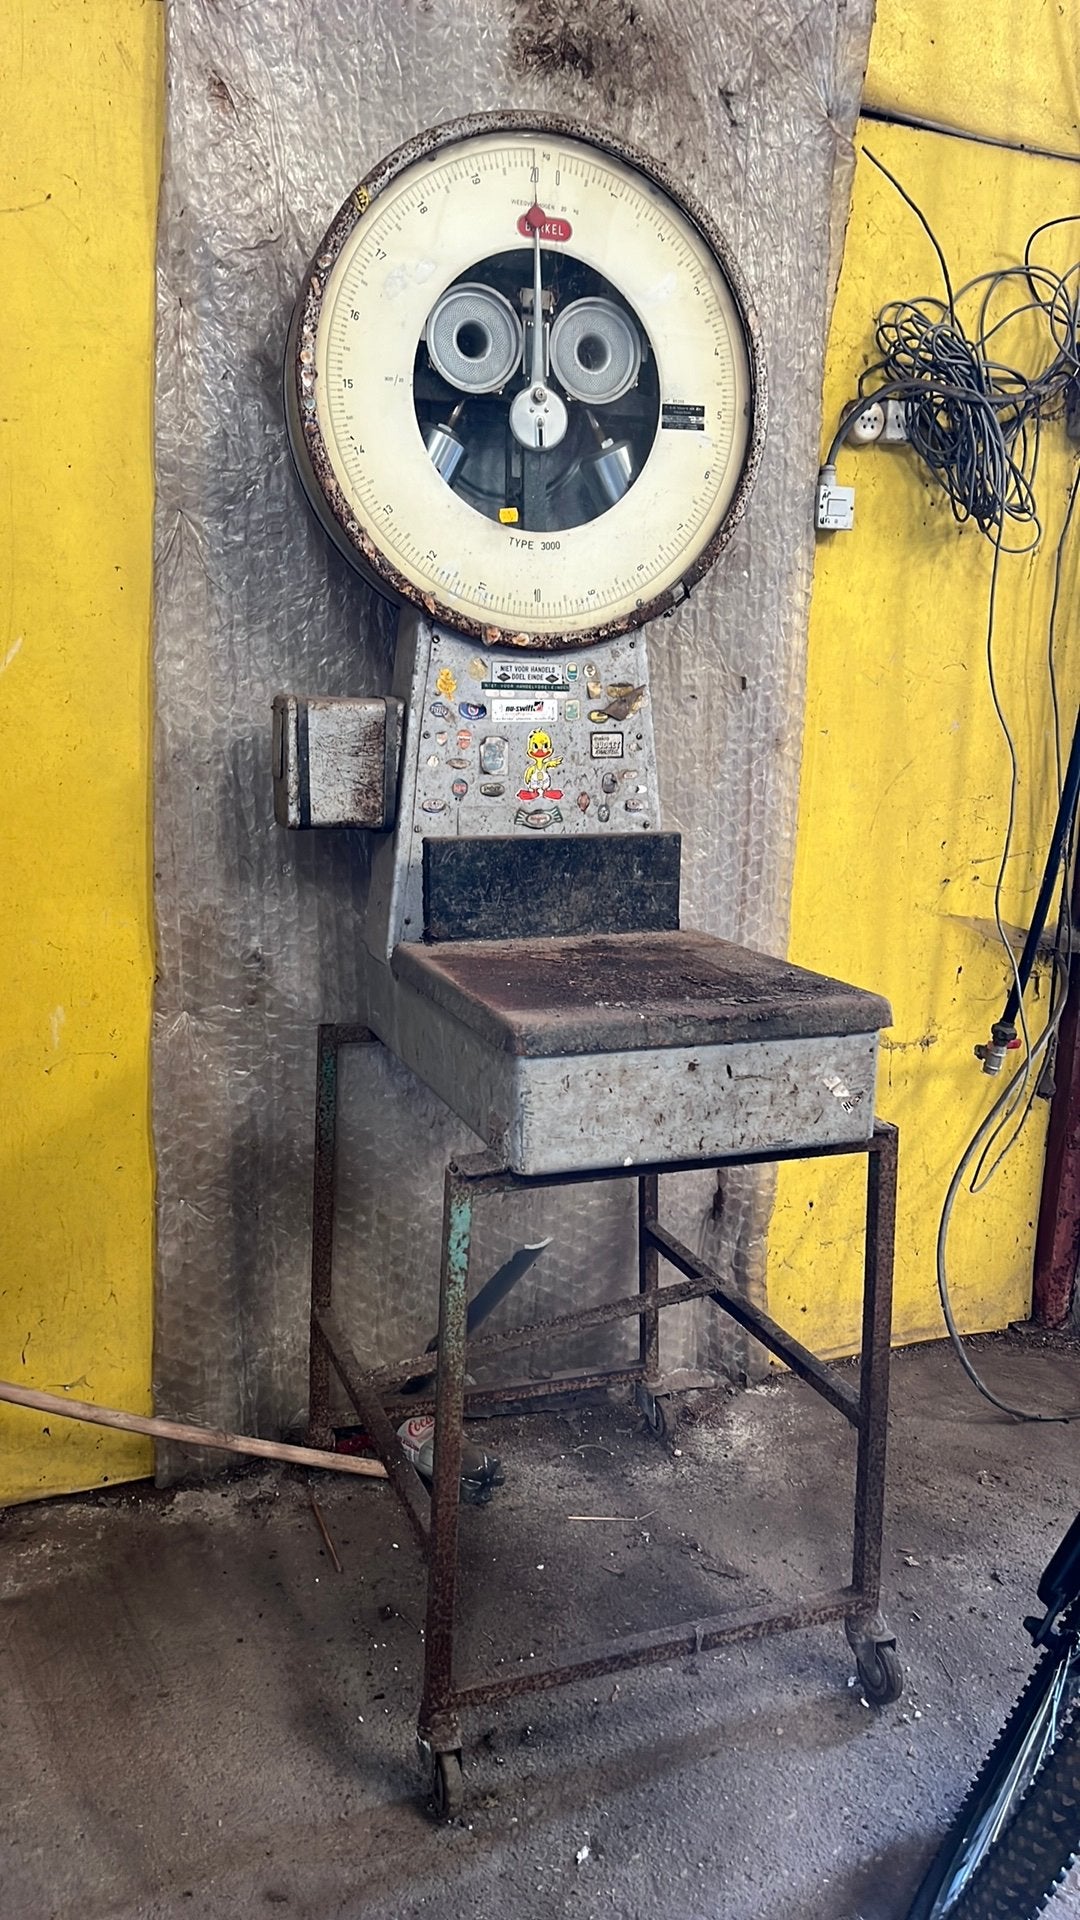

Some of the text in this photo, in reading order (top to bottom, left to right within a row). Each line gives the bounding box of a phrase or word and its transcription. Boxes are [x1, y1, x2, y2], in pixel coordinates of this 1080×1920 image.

[542, 152, 550, 161] kg
[470, 173, 481, 185] 19
[530, 166, 539, 183] 20
[555, 170, 560, 186] 0
[417, 201, 428, 214] 18
[525, 221, 564, 236] BKEL
[657, 233, 666, 242] 2
[375, 249, 387, 261] 17
[693, 286, 701, 296] 3
[350, 309, 360, 321] 16
[714, 348, 720, 356] 4
[342, 378, 354, 389] 15
[716, 410, 722, 420] 5
[353, 444, 365, 456] 14
[704, 470, 711, 480] 6
[382, 504, 394, 516] 13
[676, 523, 684, 531] 7
[509, 537, 561, 551] TYPE 3000
[426, 550, 438, 562] 12
[636, 564, 645, 572] 8
[478, 581, 488, 591] 11
[534, 588, 541, 603] 10
[587, 589, 596, 597] 9
[514, 665, 529, 673] VOOR
[530, 666, 556, 674] HANDELS
